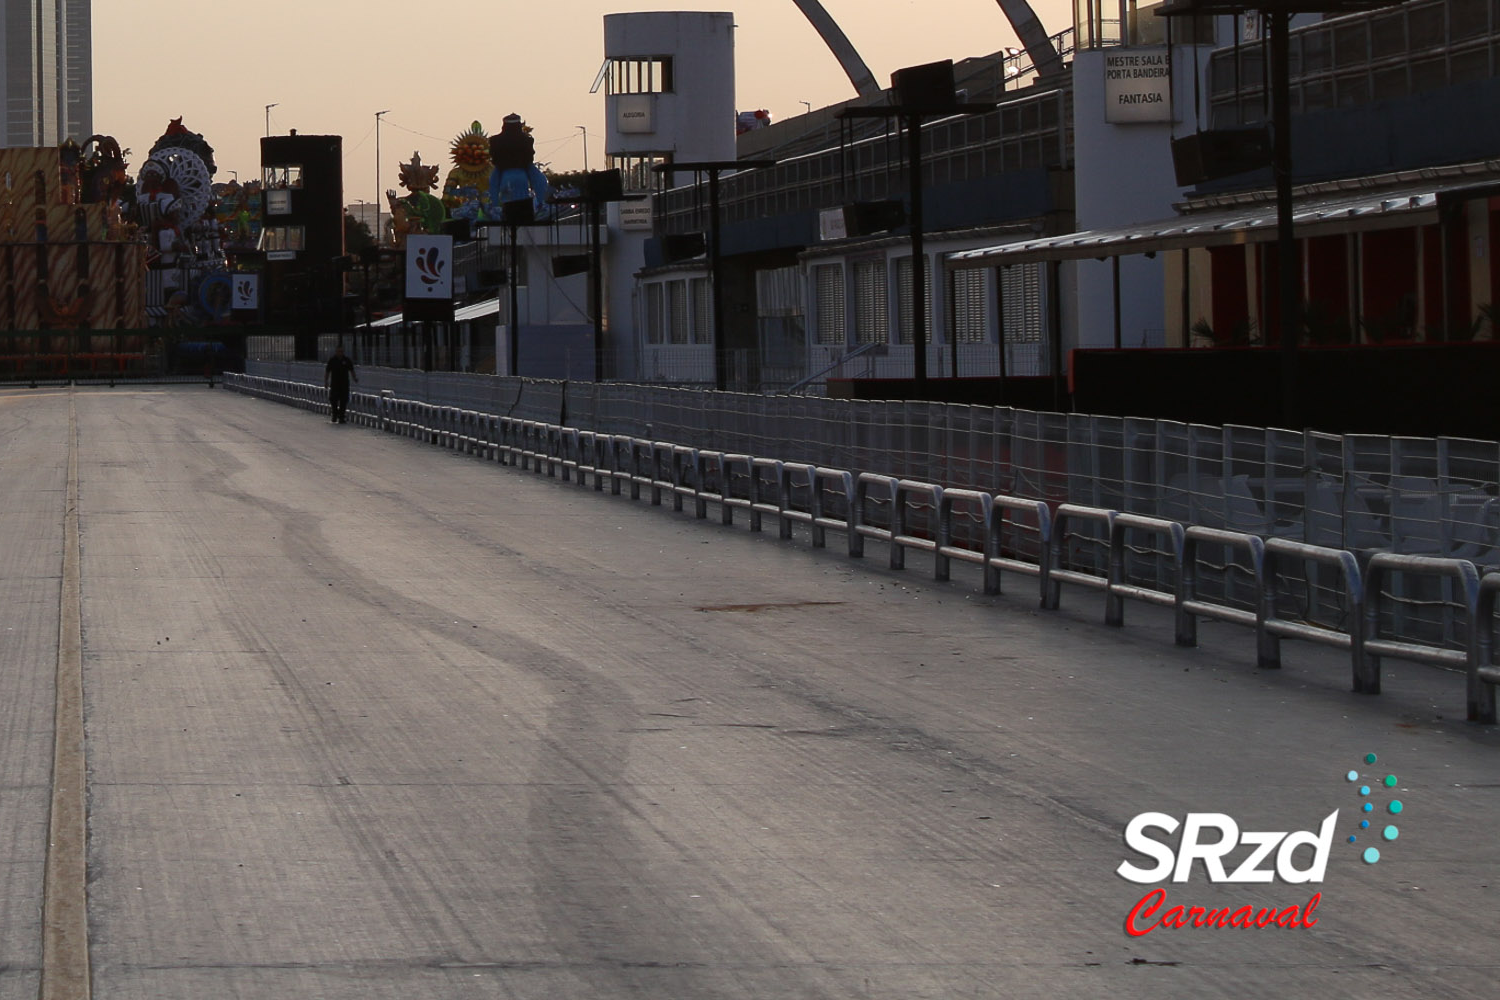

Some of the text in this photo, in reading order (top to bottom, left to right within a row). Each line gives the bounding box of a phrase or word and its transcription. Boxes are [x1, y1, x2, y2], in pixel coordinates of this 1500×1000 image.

[1107, 56, 1139, 67] MESTRE
[1141, 55, 1162, 66] SALA
[1107, 67, 1170, 79] PORTA BANDEIRA
[1118, 93, 1163, 105] FANTASIA
